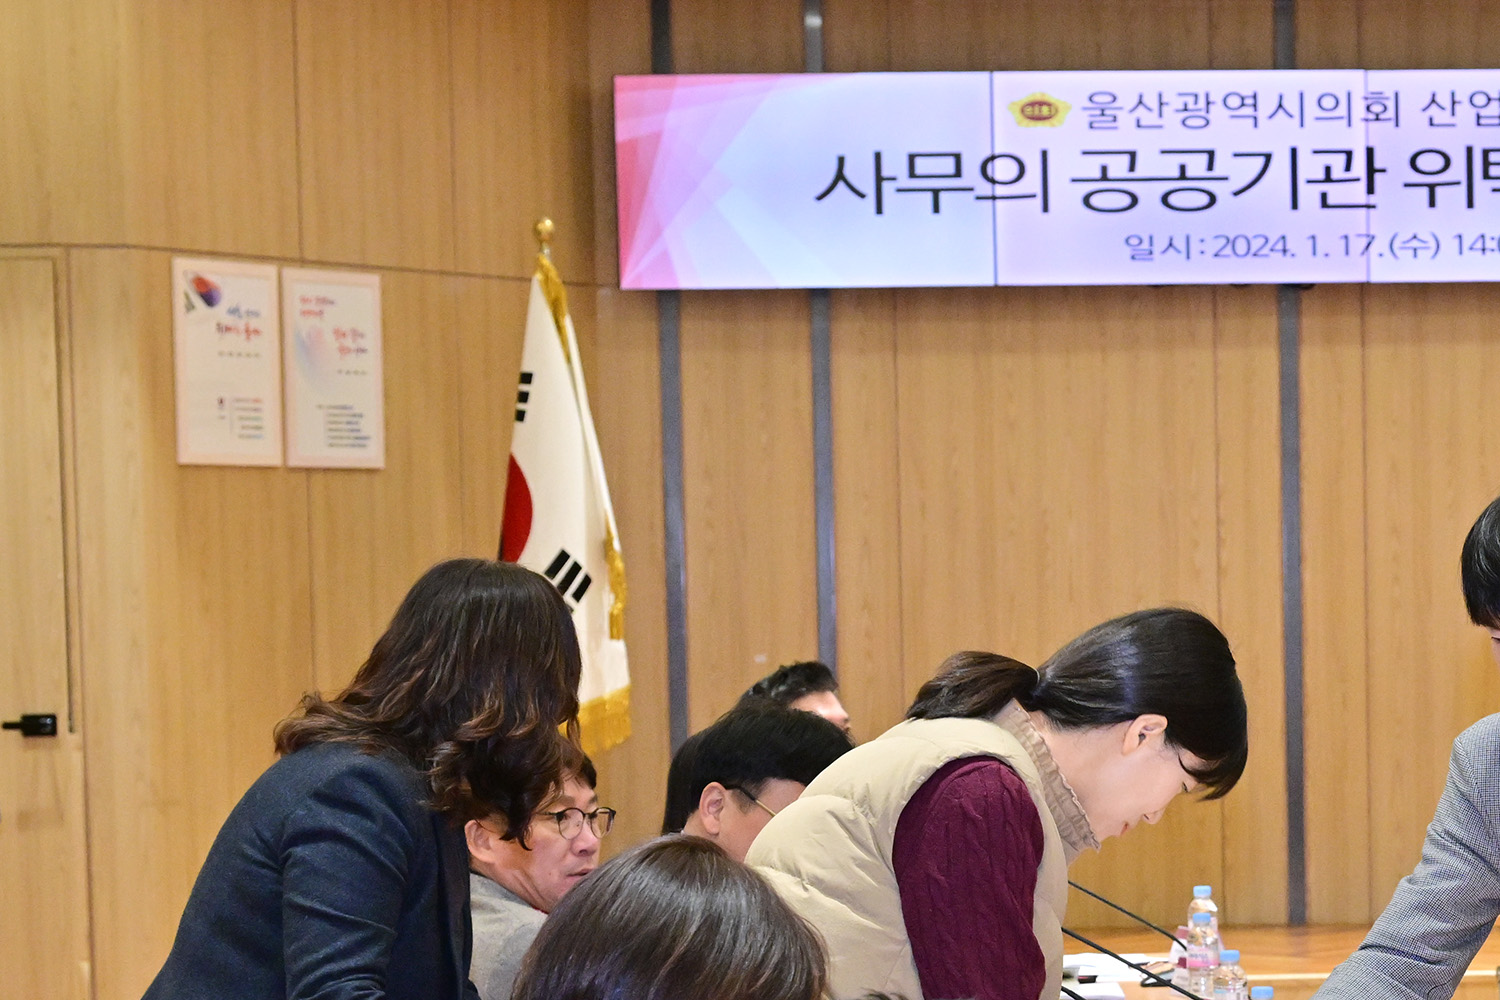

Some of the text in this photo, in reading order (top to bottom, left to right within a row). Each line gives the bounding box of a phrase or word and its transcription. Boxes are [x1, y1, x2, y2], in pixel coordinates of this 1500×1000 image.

[1081, 90, 1400, 130] 울산광역시의회
[814, 149, 1052, 216] 사무의
[1070, 145, 1388, 213] 공공기관
